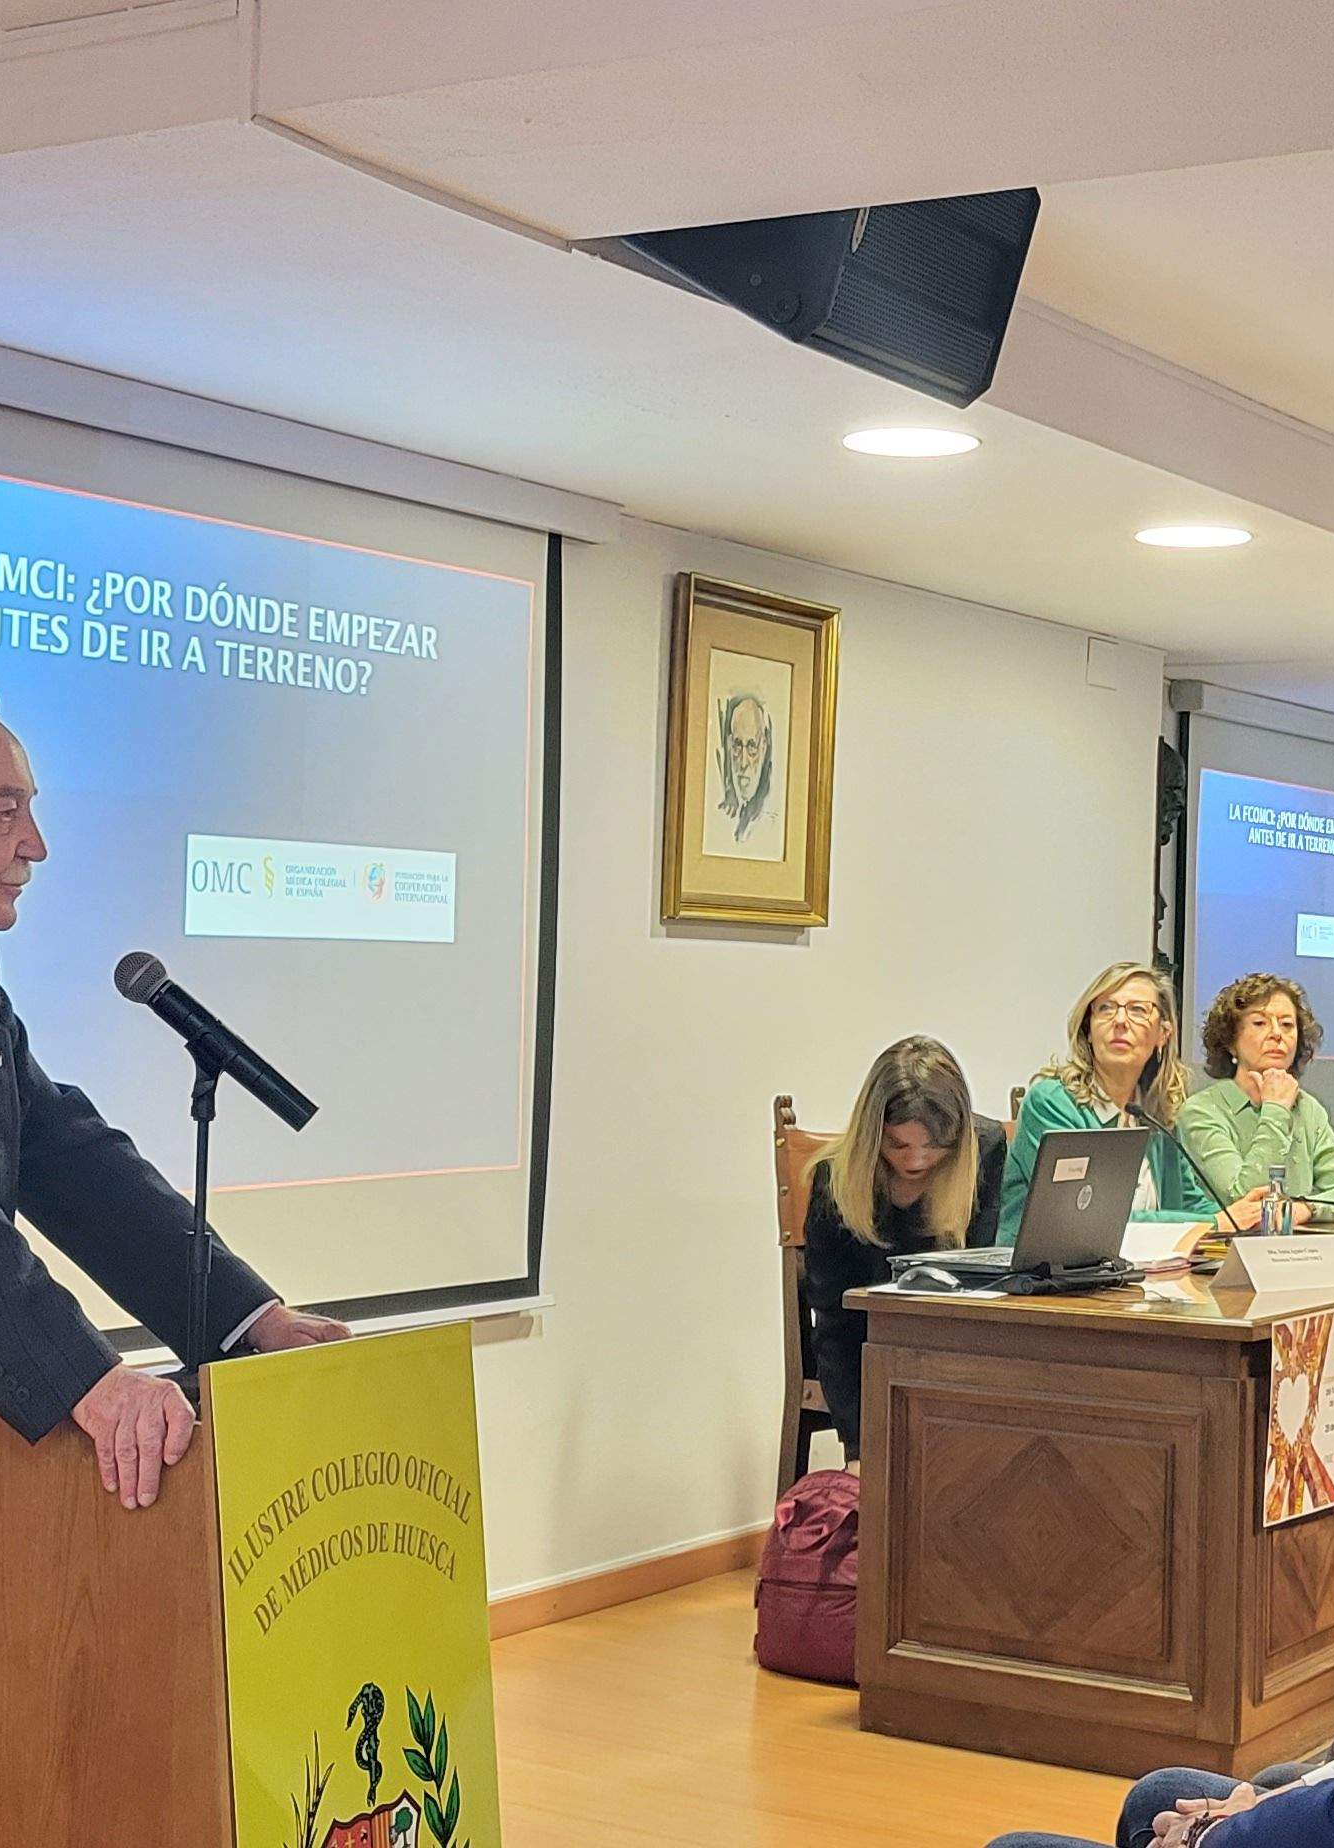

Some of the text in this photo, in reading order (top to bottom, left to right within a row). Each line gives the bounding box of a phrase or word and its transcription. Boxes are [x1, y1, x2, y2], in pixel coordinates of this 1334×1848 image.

[85, 571, 173, 621] ¿POR
[185, 581, 299, 638] DÓNDE
[308, 607, 439, 661] EMPEZAR
[82, 621, 128, 662] DE
[140, 627, 172, 668] IR
[182, 635, 207, 674] A
[216, 639, 374, 696] TERRENO?
[1229, 803, 1241, 820] LA
[1248, 827, 1274, 847] ANTES
[1275, 831, 1288, 849] DE
[191, 860, 252, 894] OMC
[226, 1451, 472, 1588] ILUSTRE COLEGIO OFICIAL
[251, 1521, 457, 1637] DE MÉDICOS DE HUESCA
